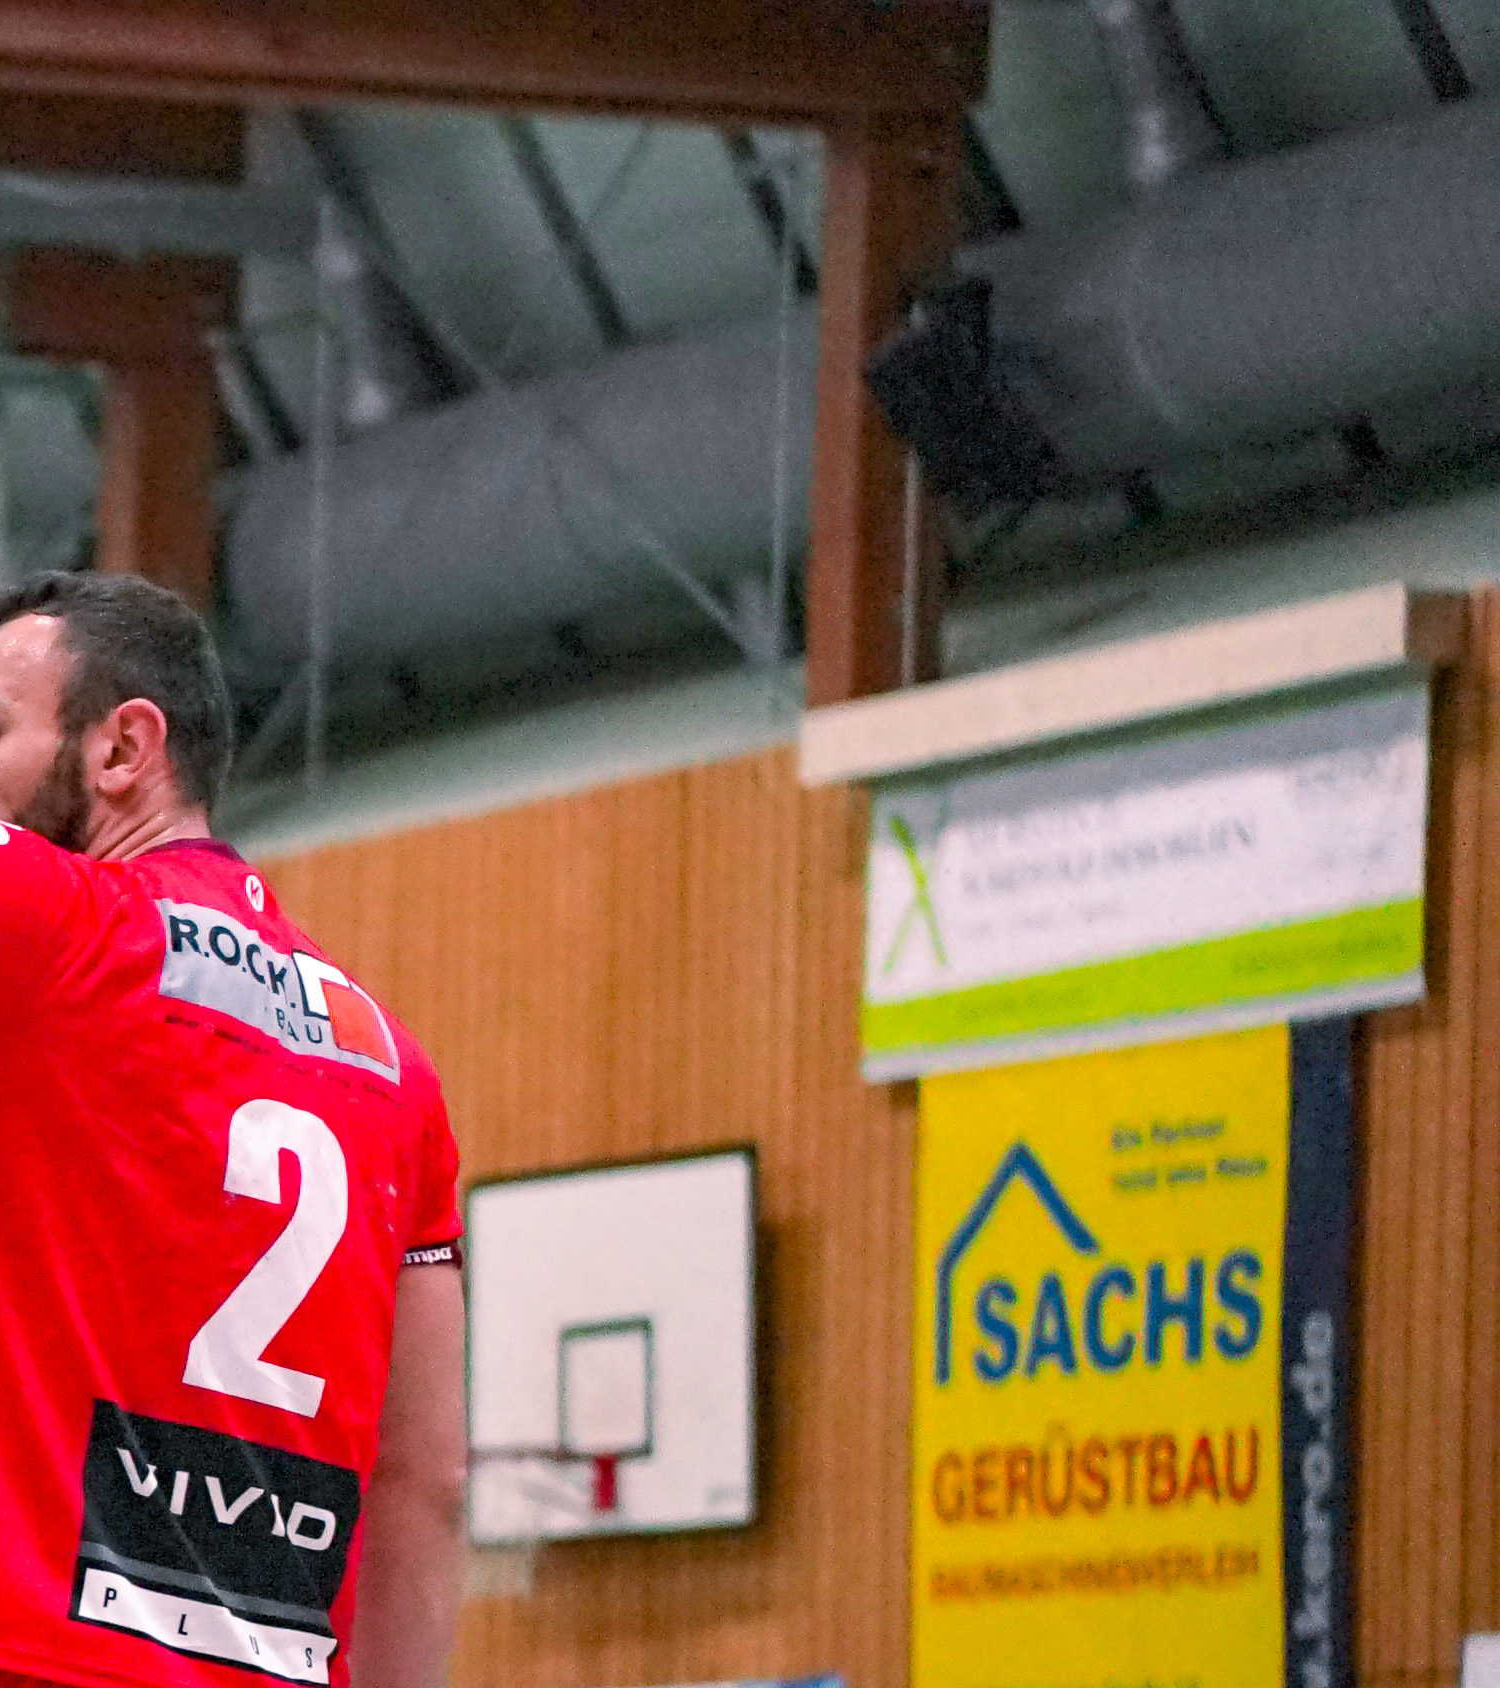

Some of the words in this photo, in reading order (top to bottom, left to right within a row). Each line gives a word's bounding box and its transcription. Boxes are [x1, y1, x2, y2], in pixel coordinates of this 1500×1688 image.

[180, 1097, 350, 1419] 2
[971, 1247, 1266, 1387] SACHS
[932, 1421, 1261, 1526] GERÜSTBAU
